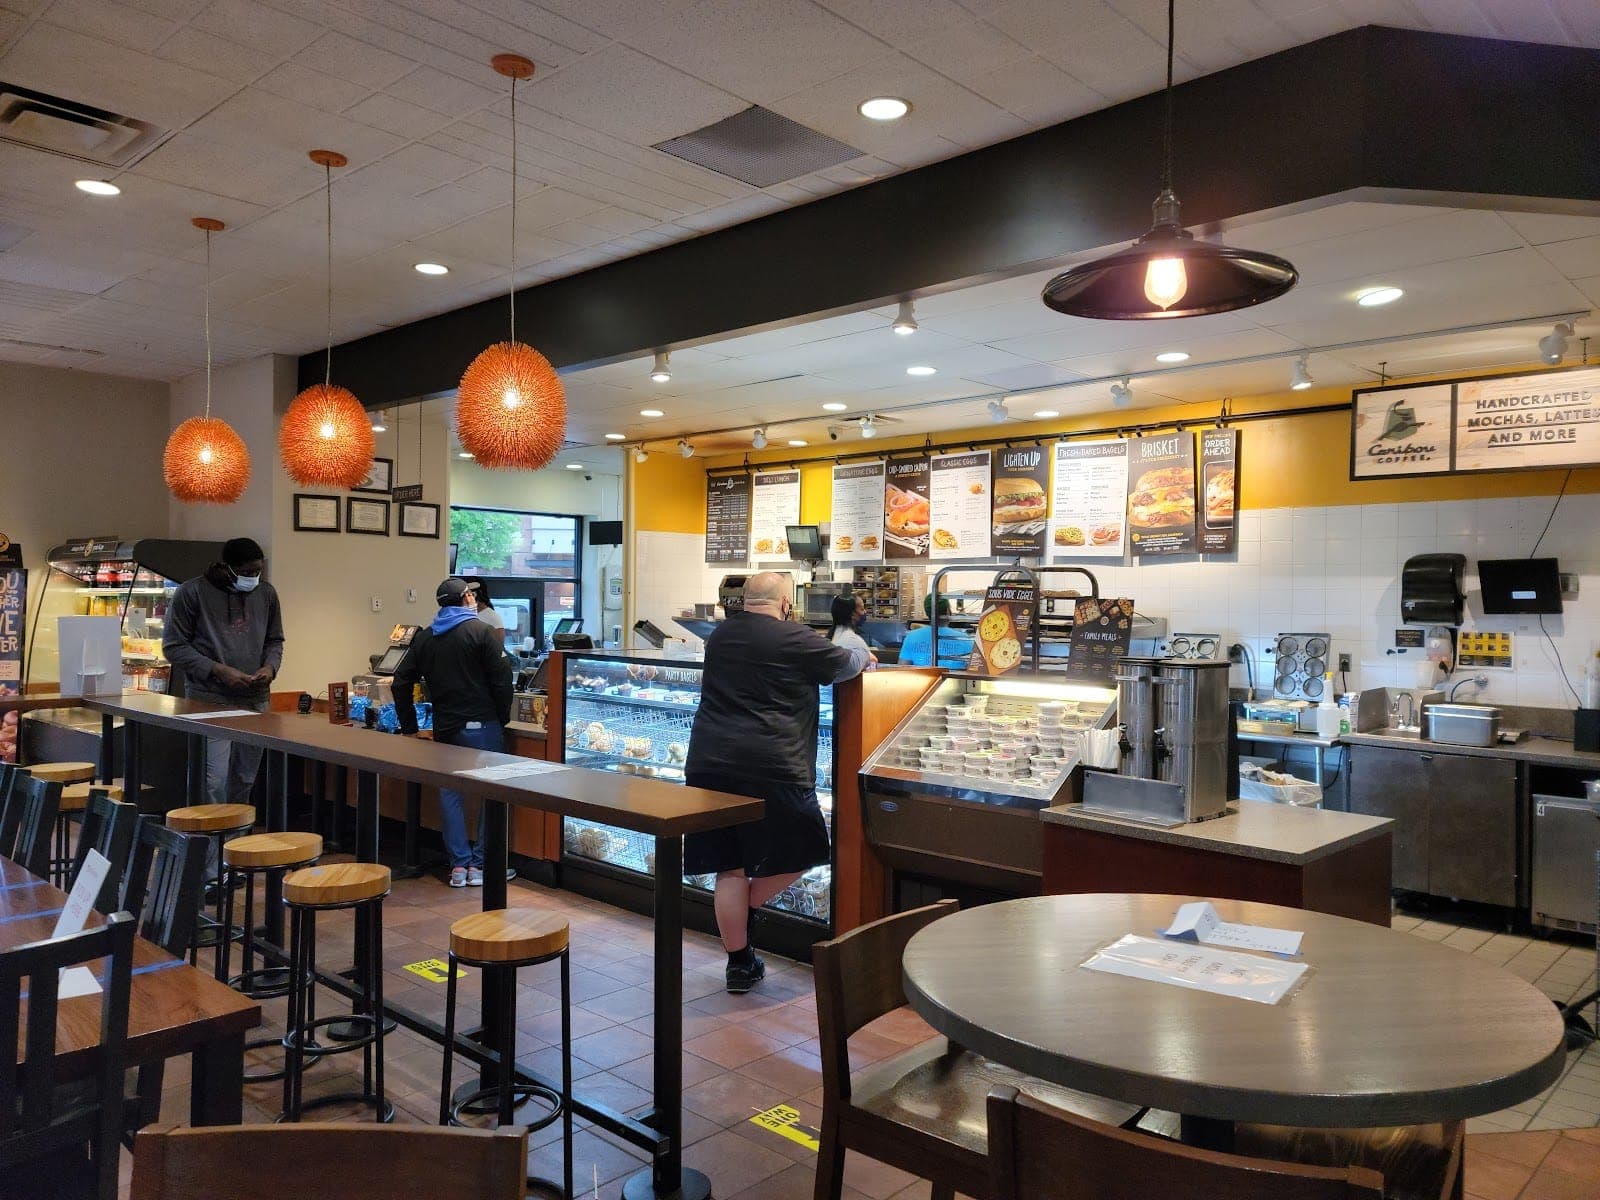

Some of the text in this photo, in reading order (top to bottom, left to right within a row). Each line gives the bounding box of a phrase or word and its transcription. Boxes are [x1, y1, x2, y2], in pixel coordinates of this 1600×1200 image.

[1476, 391, 1592, 409] HANDCRAFTED
[1467, 412, 1538, 428] MOCHAS,
[1205, 438, 1231, 448] ORDER
[1488, 428, 1576, 444] AND MORE
[1141, 438, 1179, 458] BRISKET
[1203, 446, 1231, 456] AHEAD
[1367, 443, 1437, 457] Caribou
[1003, 450, 1041, 468] LIGHTEN UP
